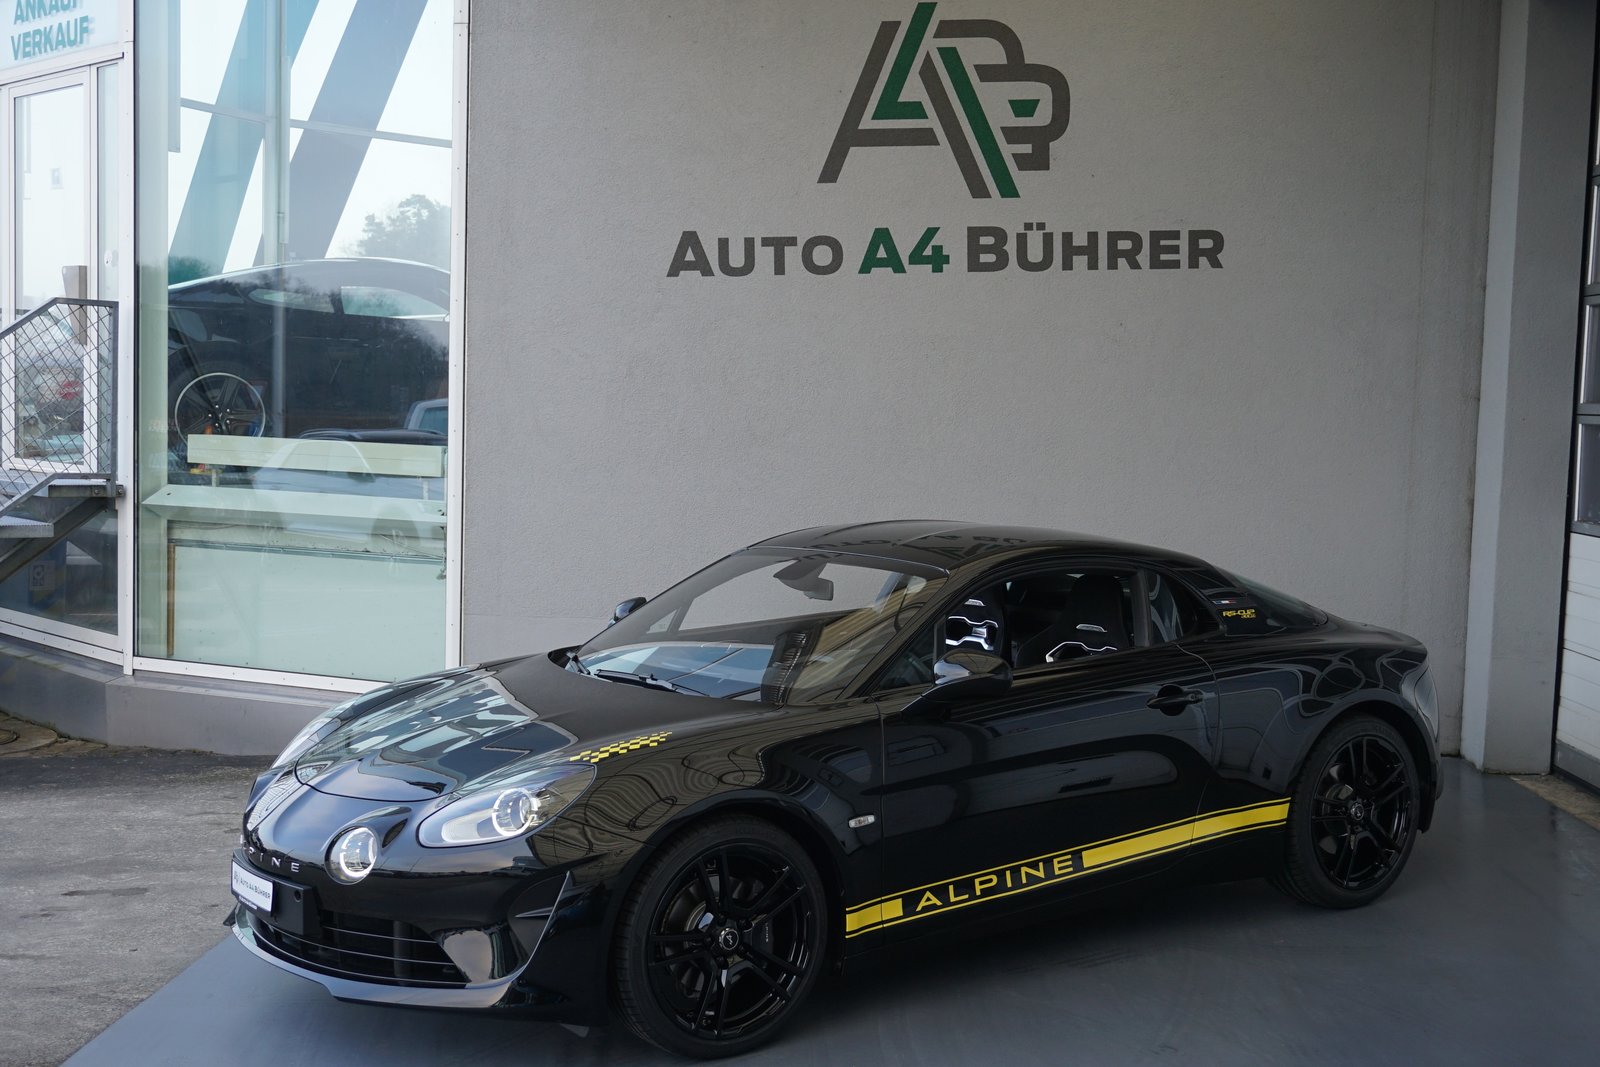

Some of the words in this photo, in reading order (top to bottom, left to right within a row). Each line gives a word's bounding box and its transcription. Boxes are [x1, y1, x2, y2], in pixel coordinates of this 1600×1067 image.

[13, 0, 78, 24] ANKA
[10, 15, 89, 60] VERKAUF
[857, 226, 950, 275] A4
[966, 222, 1225, 273] BÜHRER
[915, 854, 1074, 912] ALPINE
